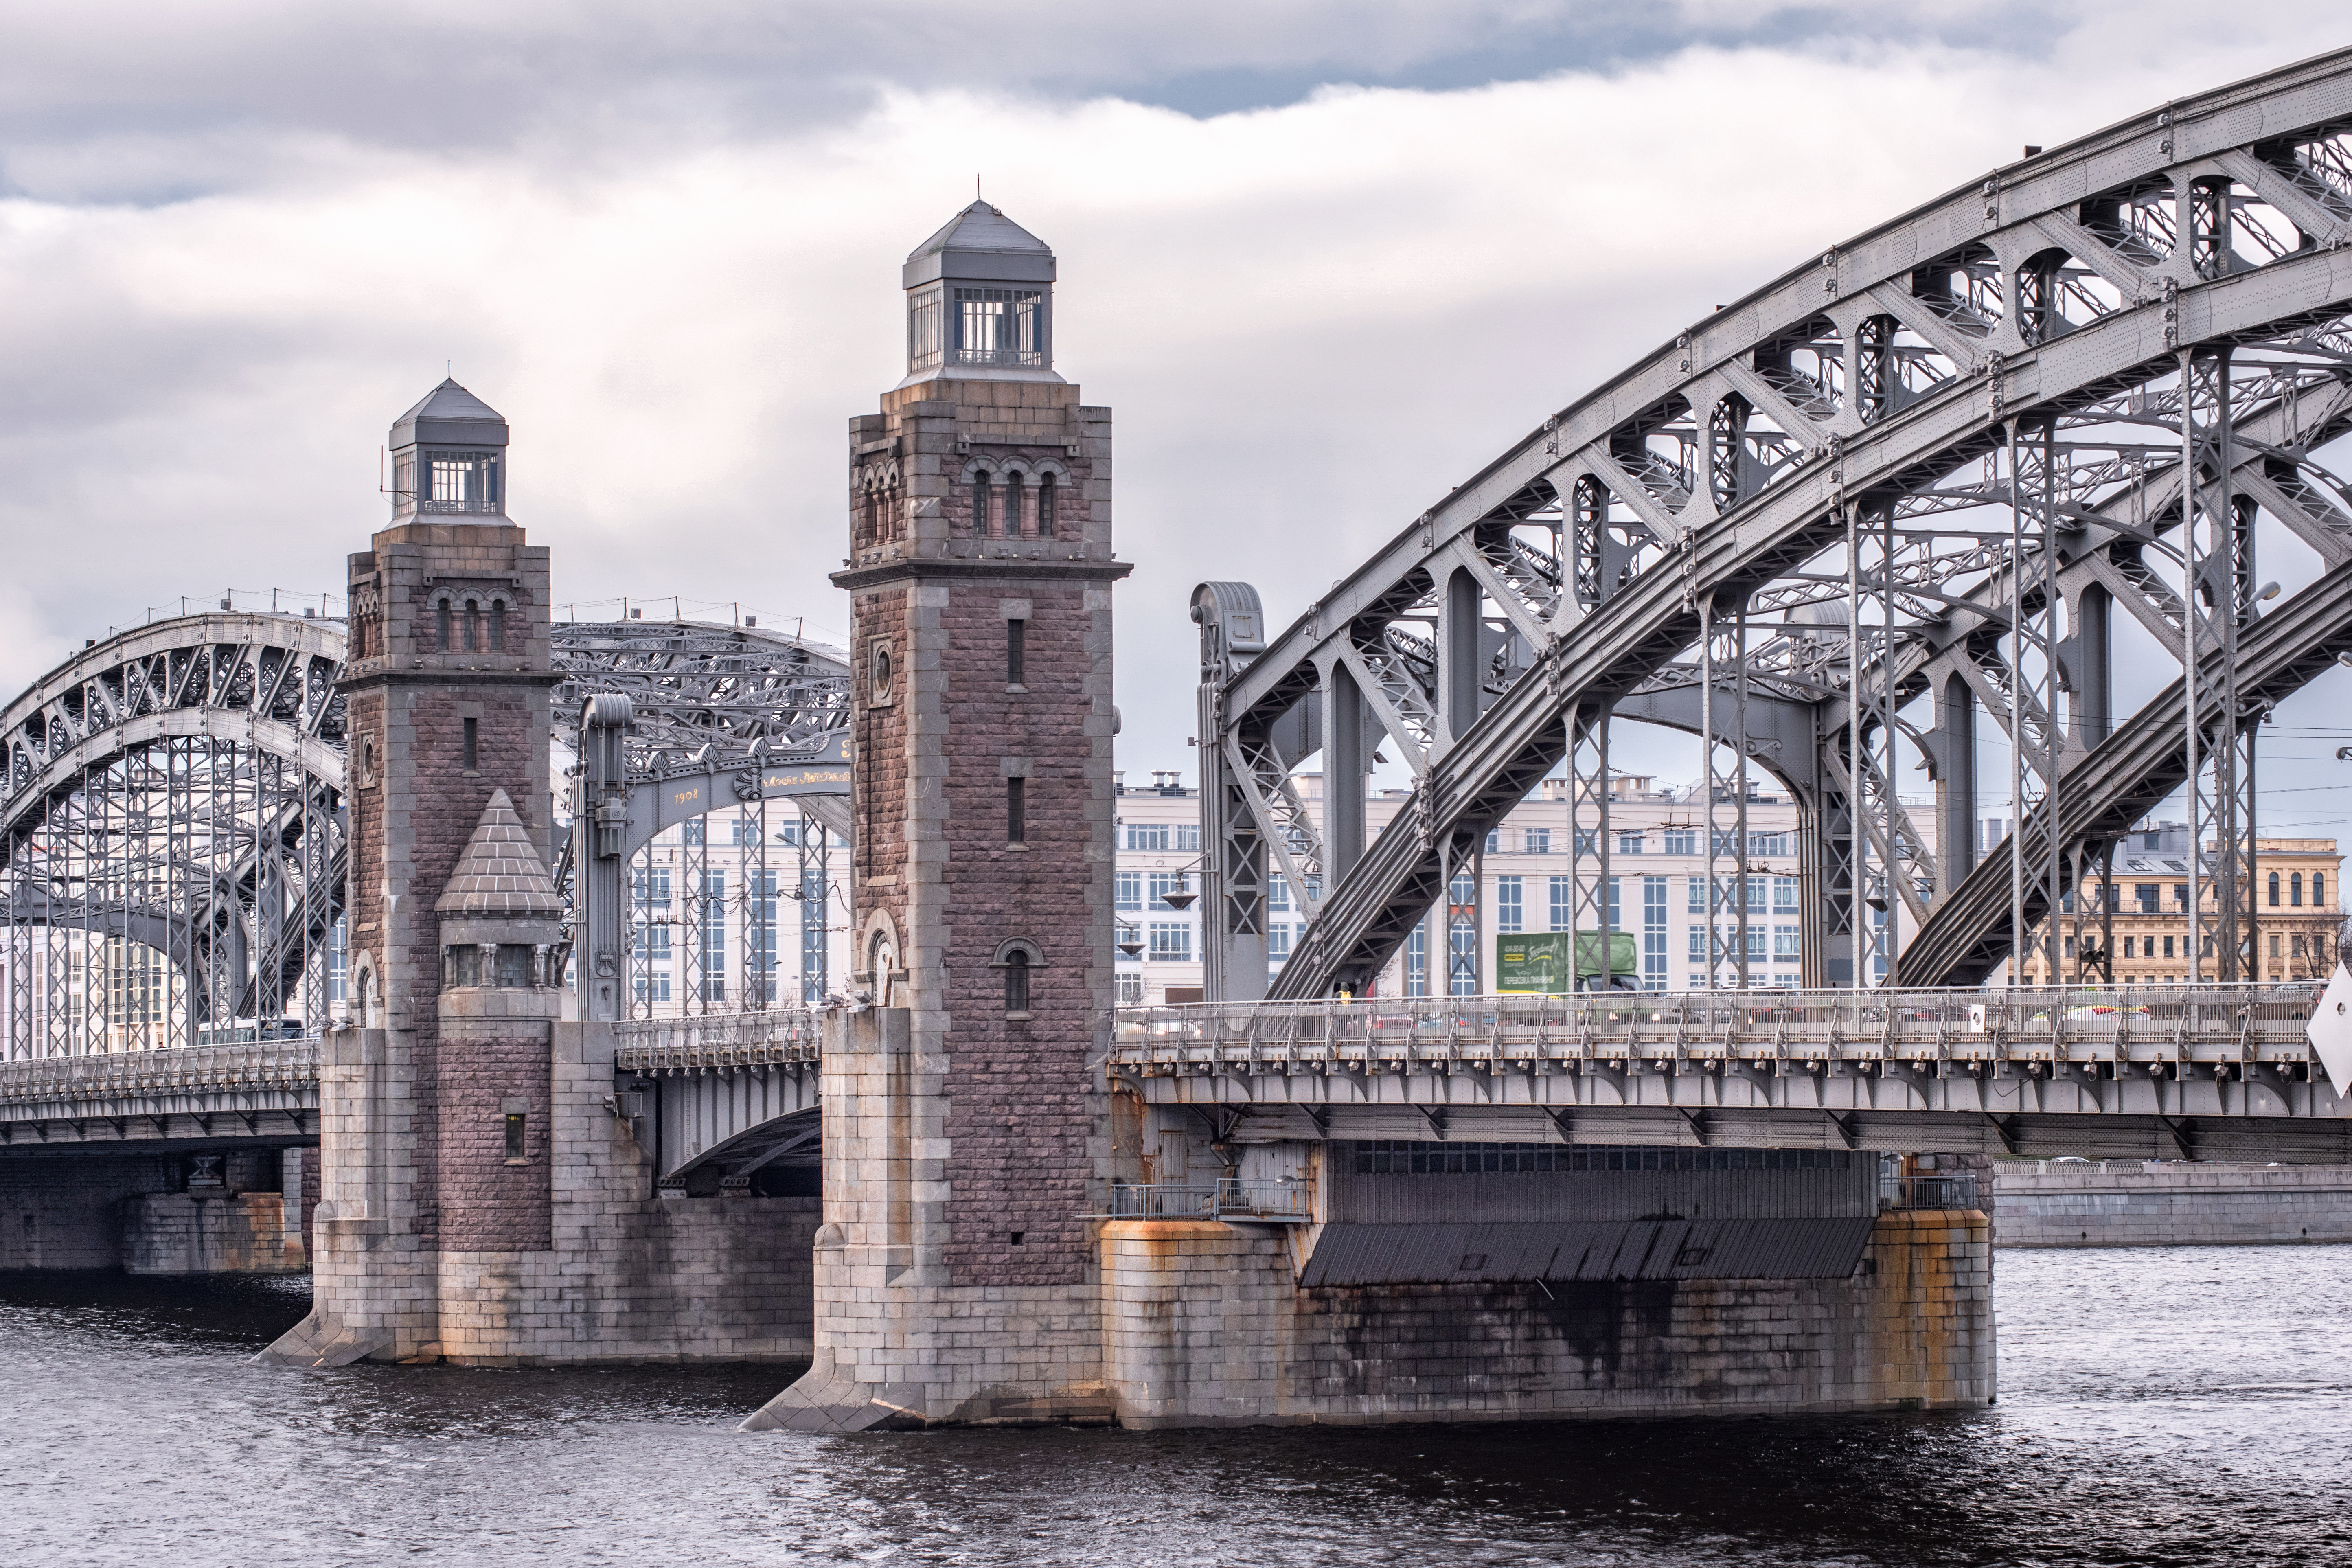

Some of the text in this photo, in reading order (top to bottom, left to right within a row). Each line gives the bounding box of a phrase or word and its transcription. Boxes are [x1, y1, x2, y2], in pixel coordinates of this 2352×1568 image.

[674, 789, 698, 805] 1908
[1748, 890, 1764, 901] 39
[1774, 890, 1790, 901] ДО
[1748, 938, 1765, 949] 03
[1504, 976, 1554, 985] ПЕРЕВОЗКА ПИАНИНО
